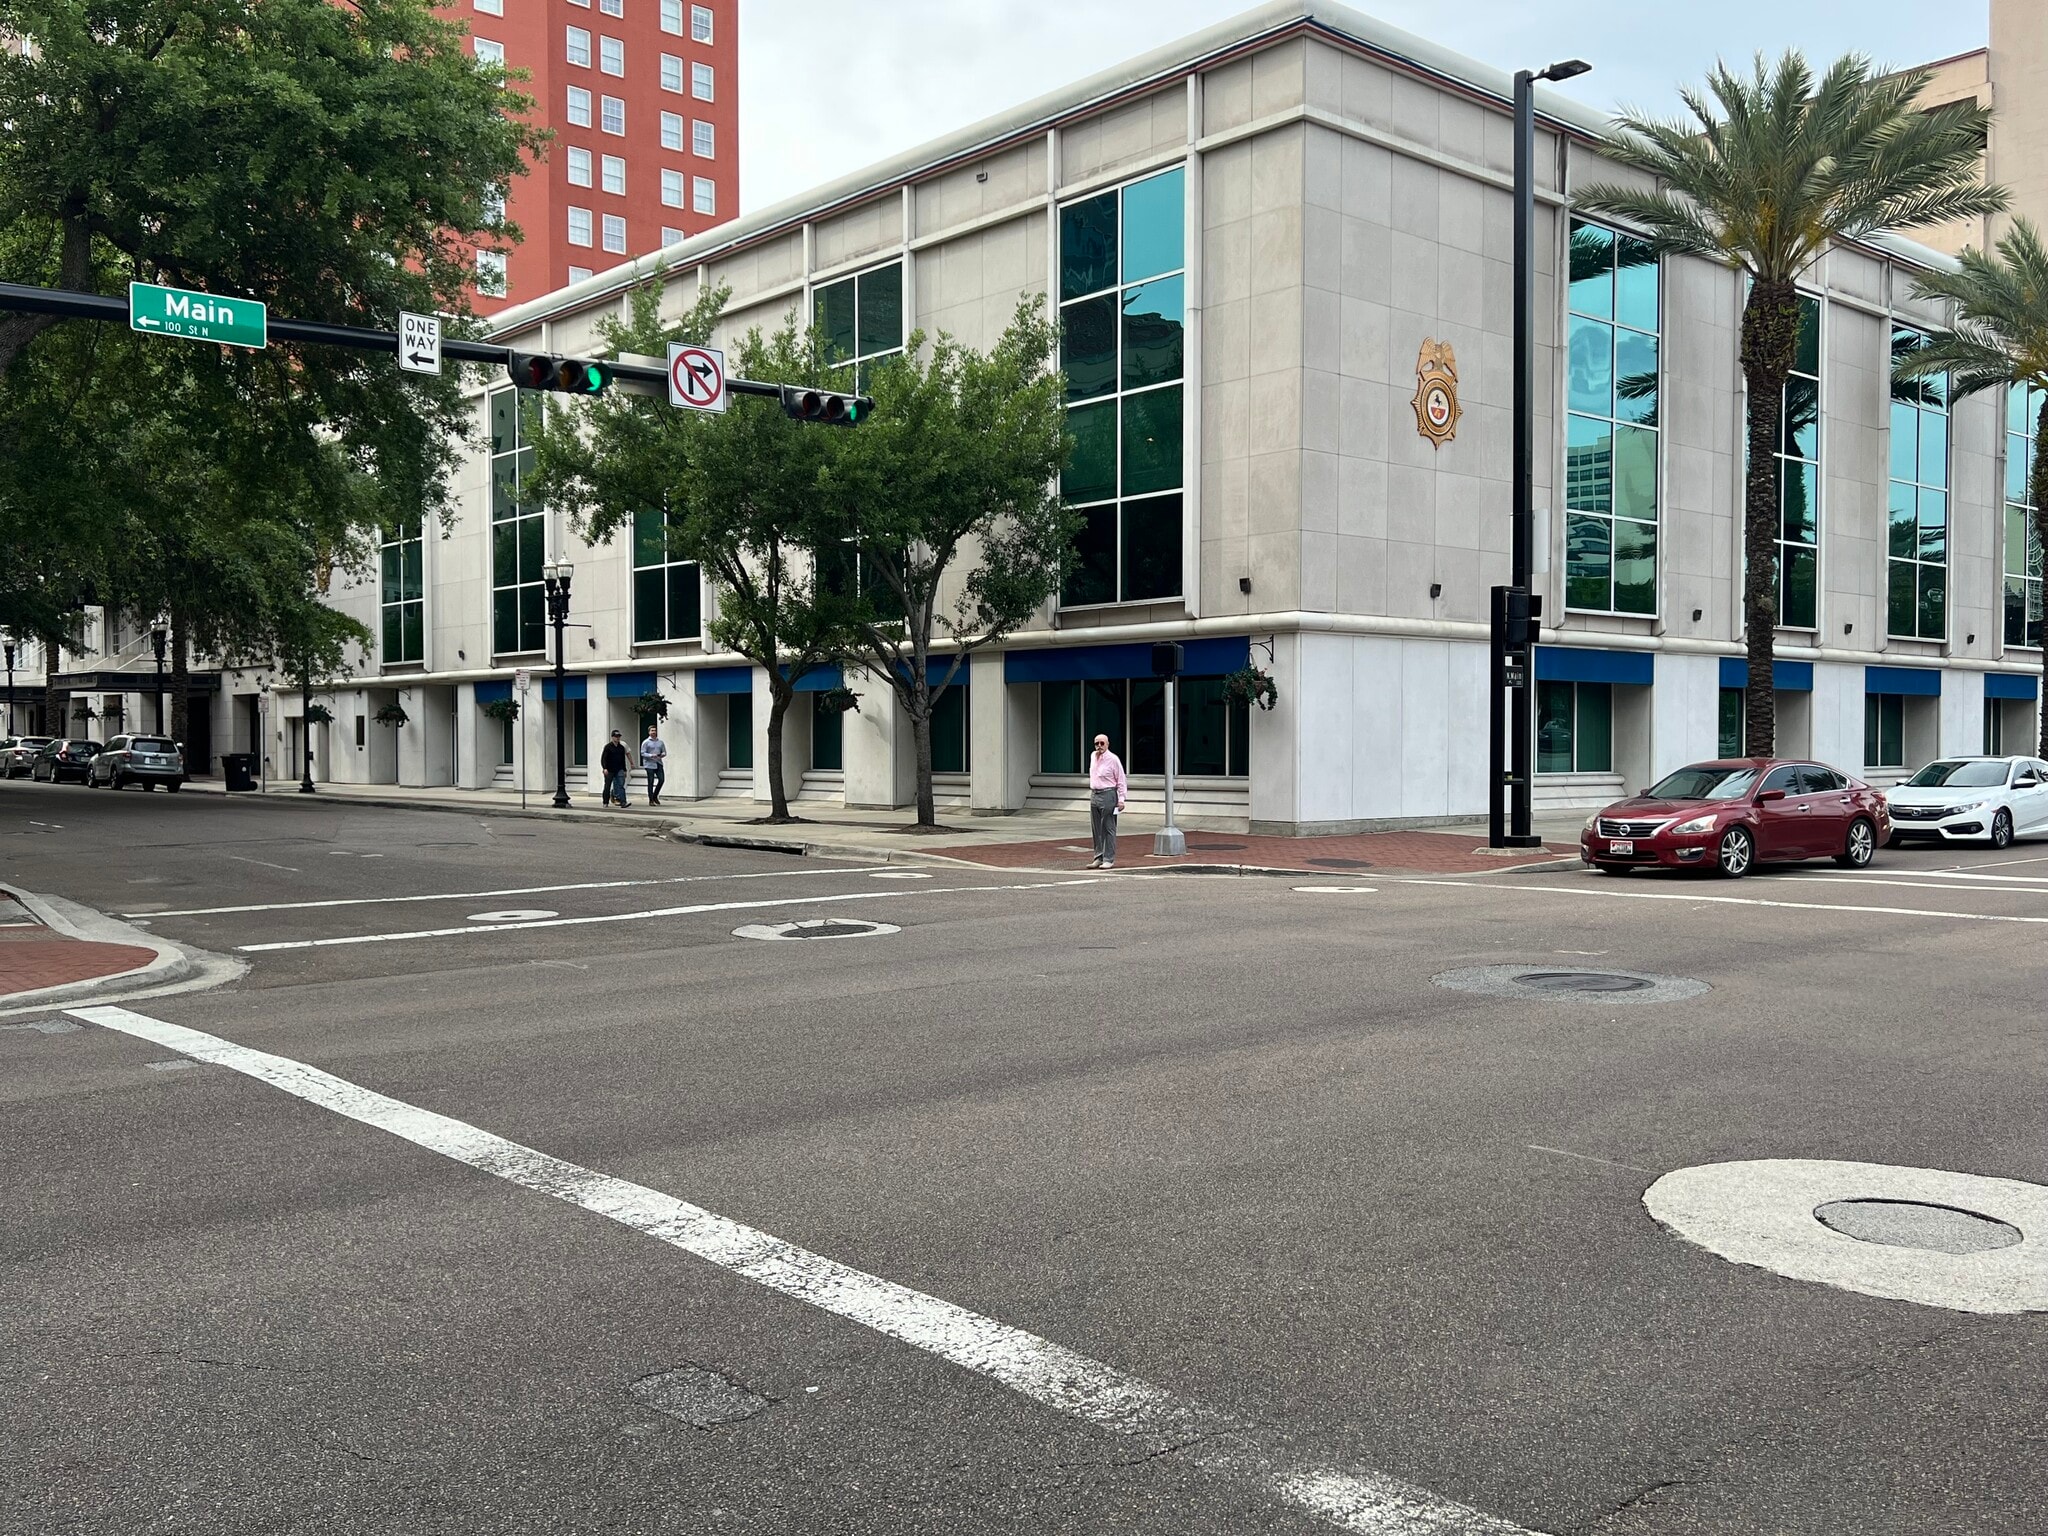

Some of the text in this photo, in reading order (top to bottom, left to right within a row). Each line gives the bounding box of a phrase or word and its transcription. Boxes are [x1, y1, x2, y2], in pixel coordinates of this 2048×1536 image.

[165, 293, 234, 325] Main
[165, 321, 209, 336] 100 St N
[406, 318, 435, 335] ONE
[405, 334, 436, 350] WAY
